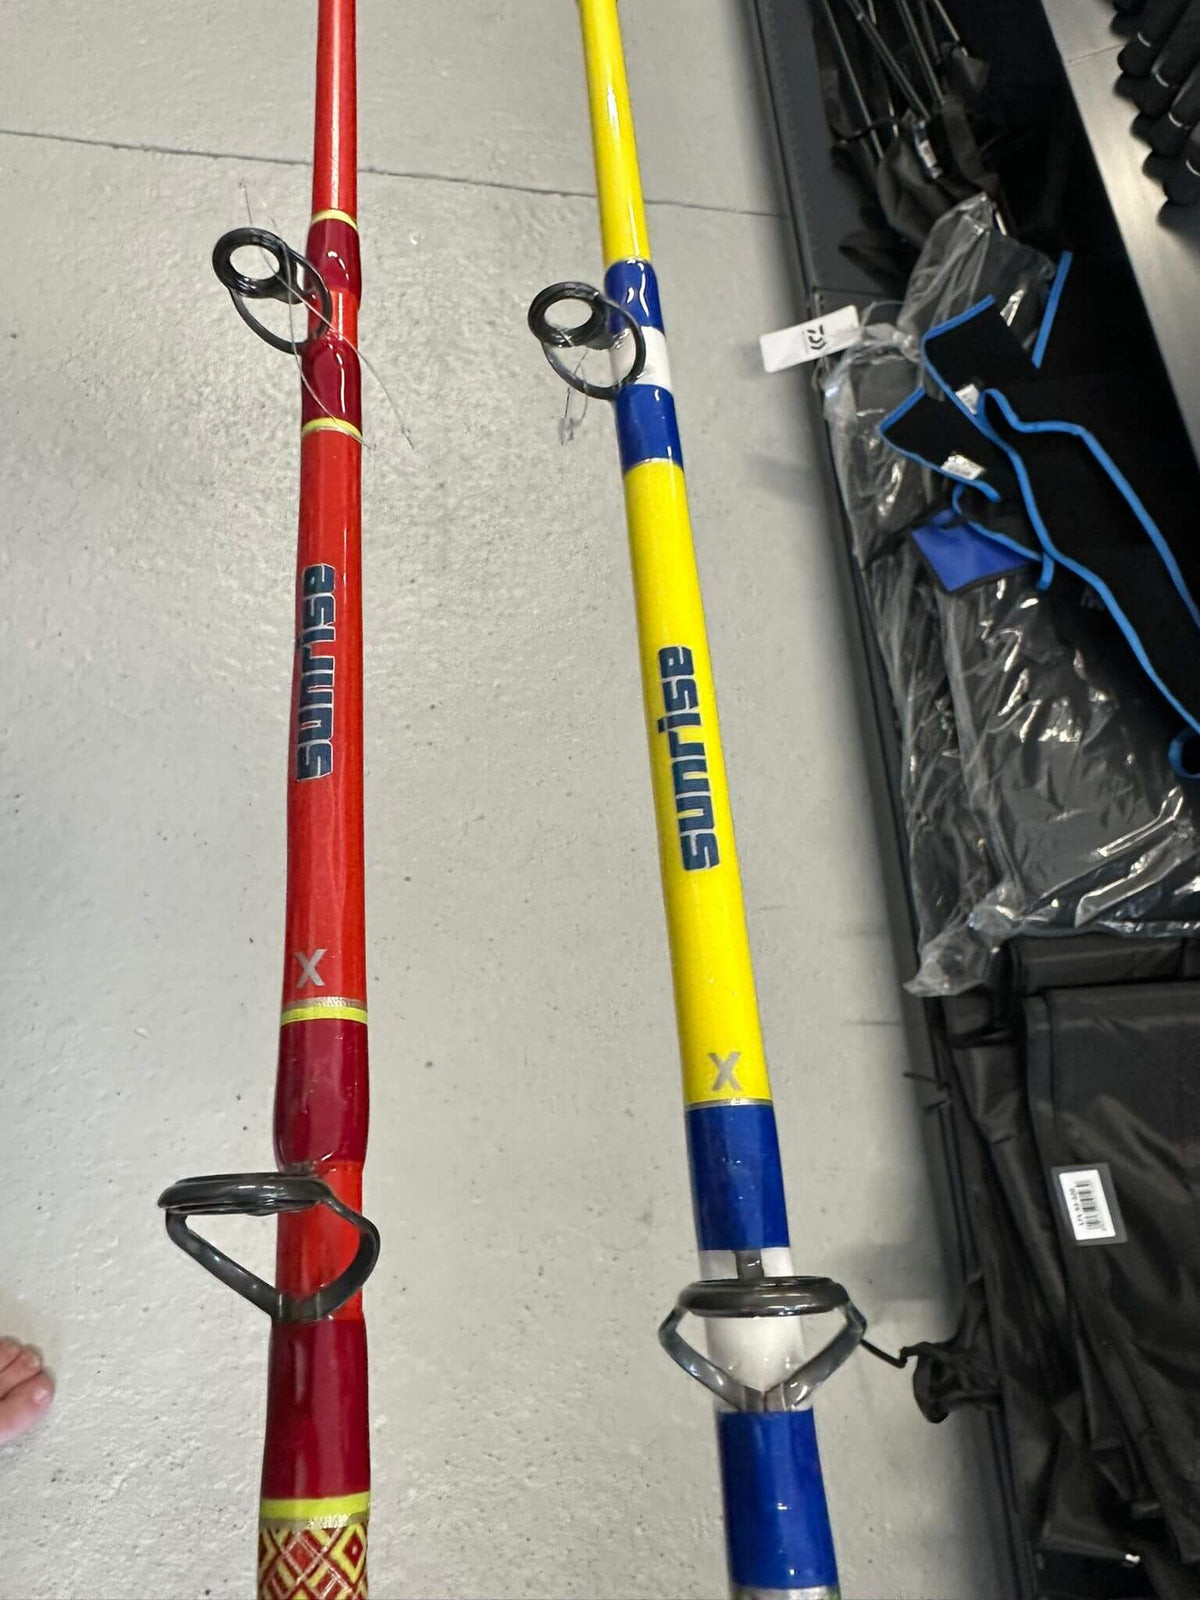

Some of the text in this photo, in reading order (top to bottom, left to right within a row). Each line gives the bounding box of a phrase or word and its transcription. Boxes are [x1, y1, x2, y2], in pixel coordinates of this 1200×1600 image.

[296, 564, 335, 781] sunrise
[658, 646, 720, 871] sunrise
[295, 949, 326, 988] X
[707, 1051, 741, 1092] X
